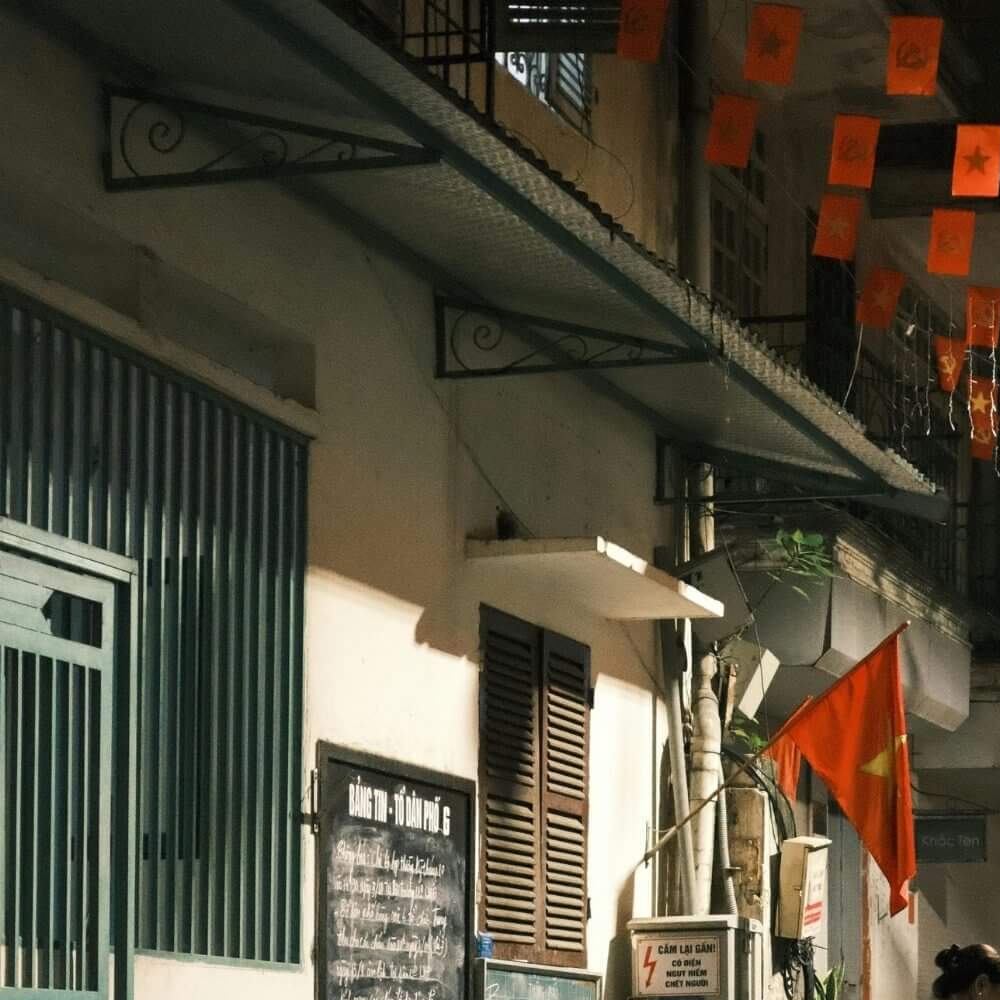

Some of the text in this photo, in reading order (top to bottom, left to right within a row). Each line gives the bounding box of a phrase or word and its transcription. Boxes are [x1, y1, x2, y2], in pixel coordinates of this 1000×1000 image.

[348, 775, 373, 820] BẢNG
[373, 788, 388, 823] TIN
[405, 790, 422, 829] DÂN
[680, 944, 693, 956] LẠI
